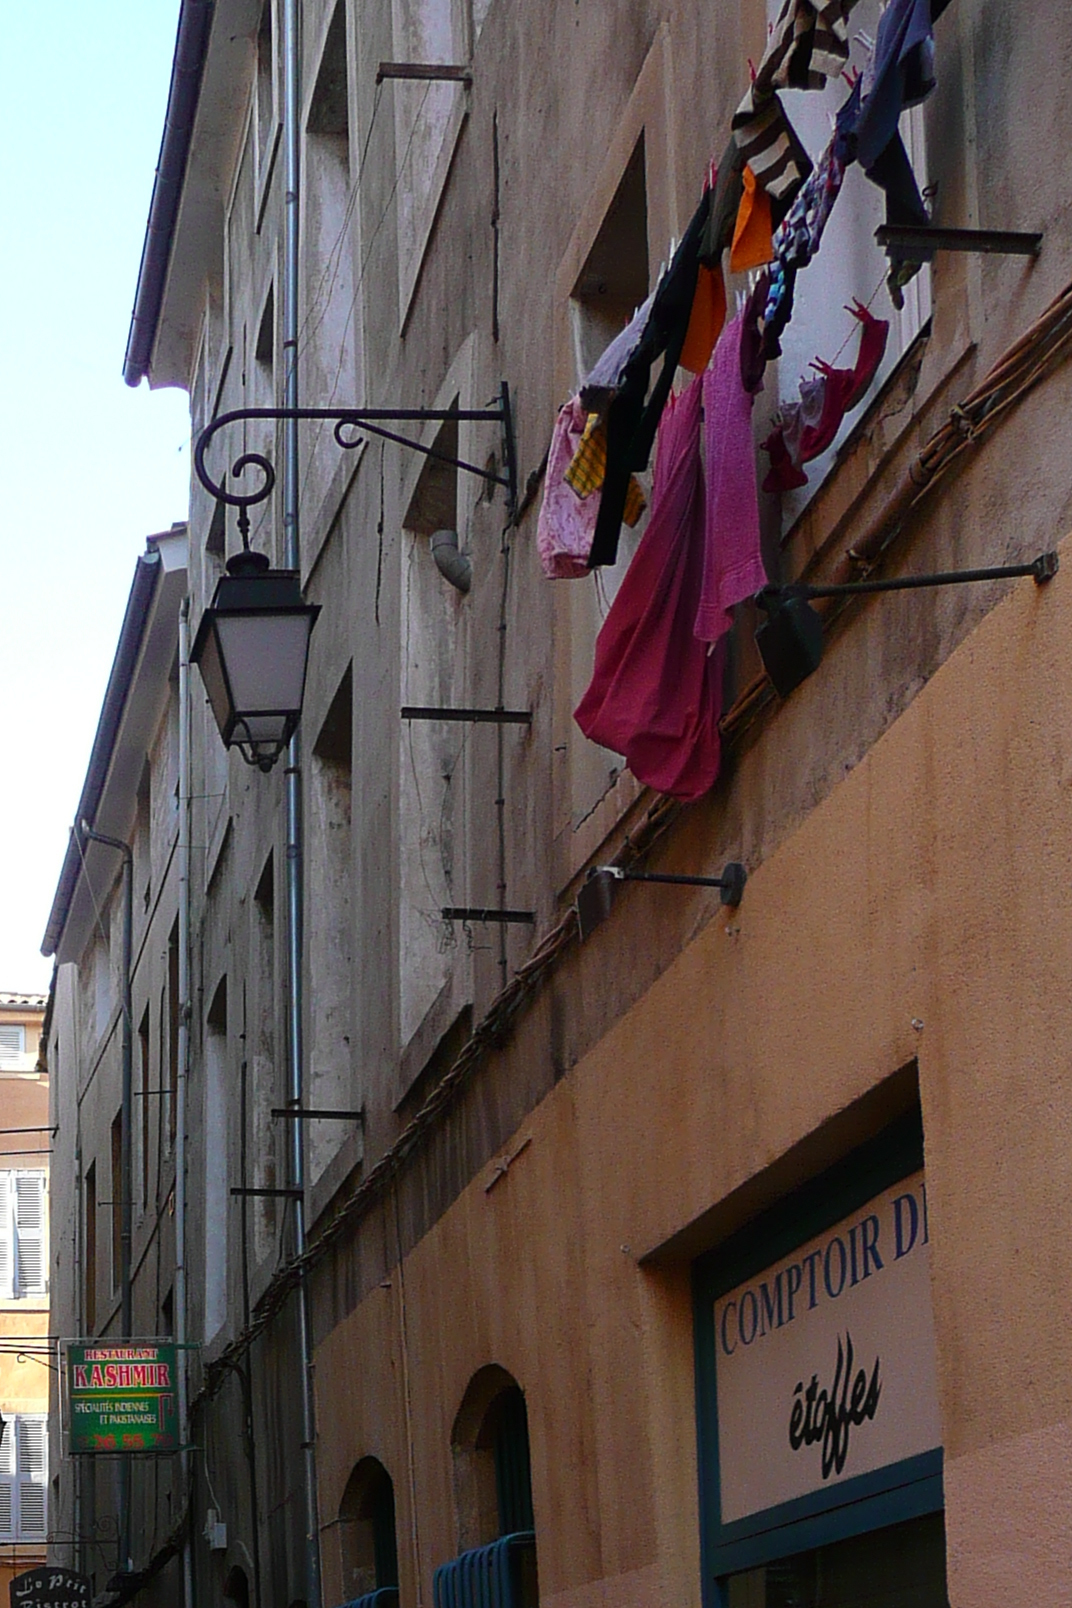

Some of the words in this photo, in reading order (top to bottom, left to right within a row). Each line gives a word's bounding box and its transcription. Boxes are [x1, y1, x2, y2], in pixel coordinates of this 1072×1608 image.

[721, 1214, 884, 1356] COMPTOIR
[84, 1348, 158, 1361] RESTAURANT
[73, 1363, 171, 1389] KASHMIR
[114, 1401, 149, 1412] INDIENNES
[789, 1328, 883, 1480] étoffes
[100, 1414, 108, 1425] ET
[109, 1413, 157, 1424] PAKISTANAISES
[122, 1433, 145, 1449] 55
